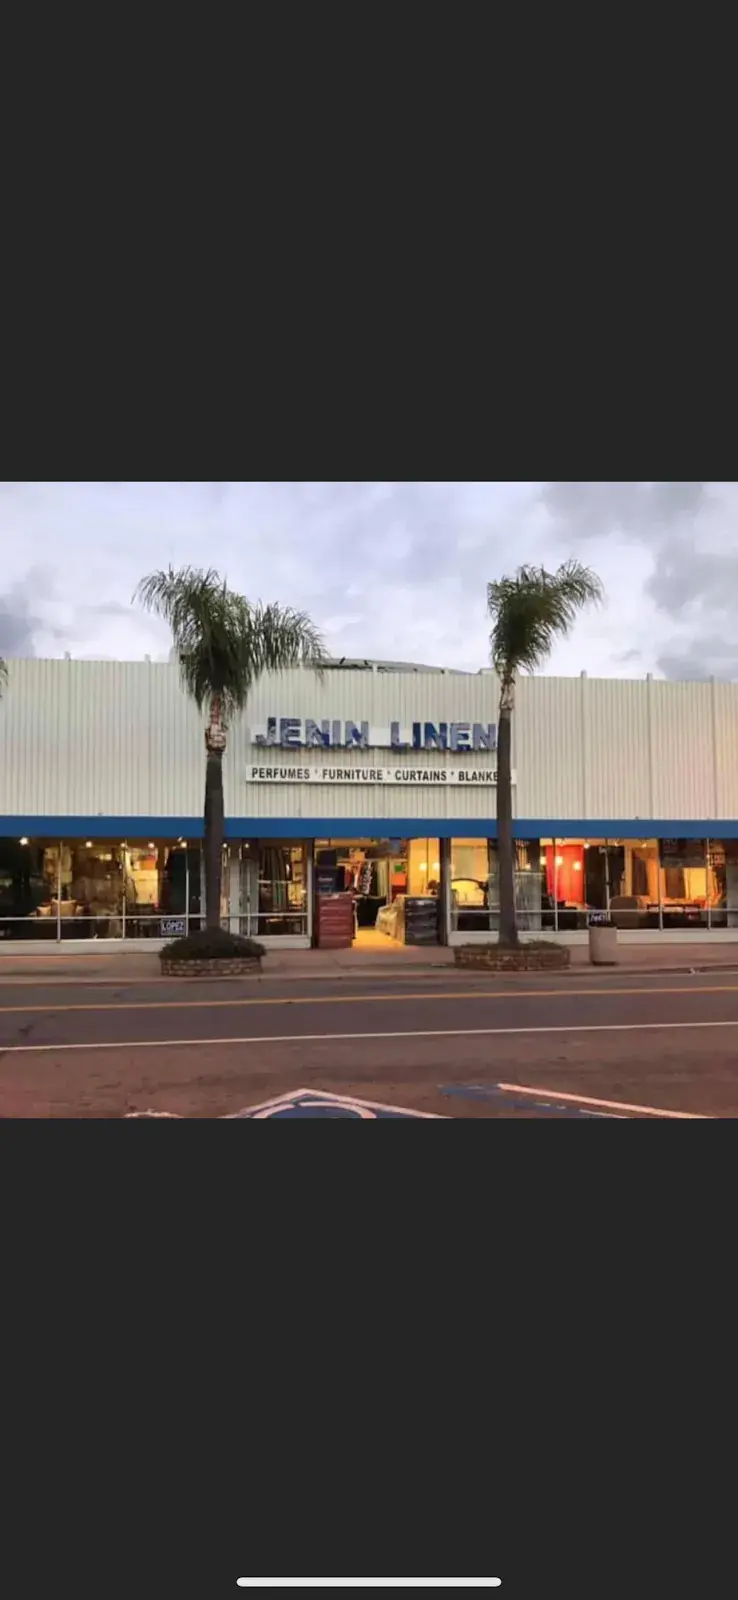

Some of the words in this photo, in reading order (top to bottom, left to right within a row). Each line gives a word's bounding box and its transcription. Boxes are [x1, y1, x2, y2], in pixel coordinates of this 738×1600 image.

[255, 717, 368, 748] JENIN
[390, 722, 496, 751] LINEN
[251, 767, 310, 779] PERFUMES
[322, 768, 383, 780] FURNITURE
[394, 770, 447, 781] CURTAINS
[458, 771, 499, 782] BLANKE
